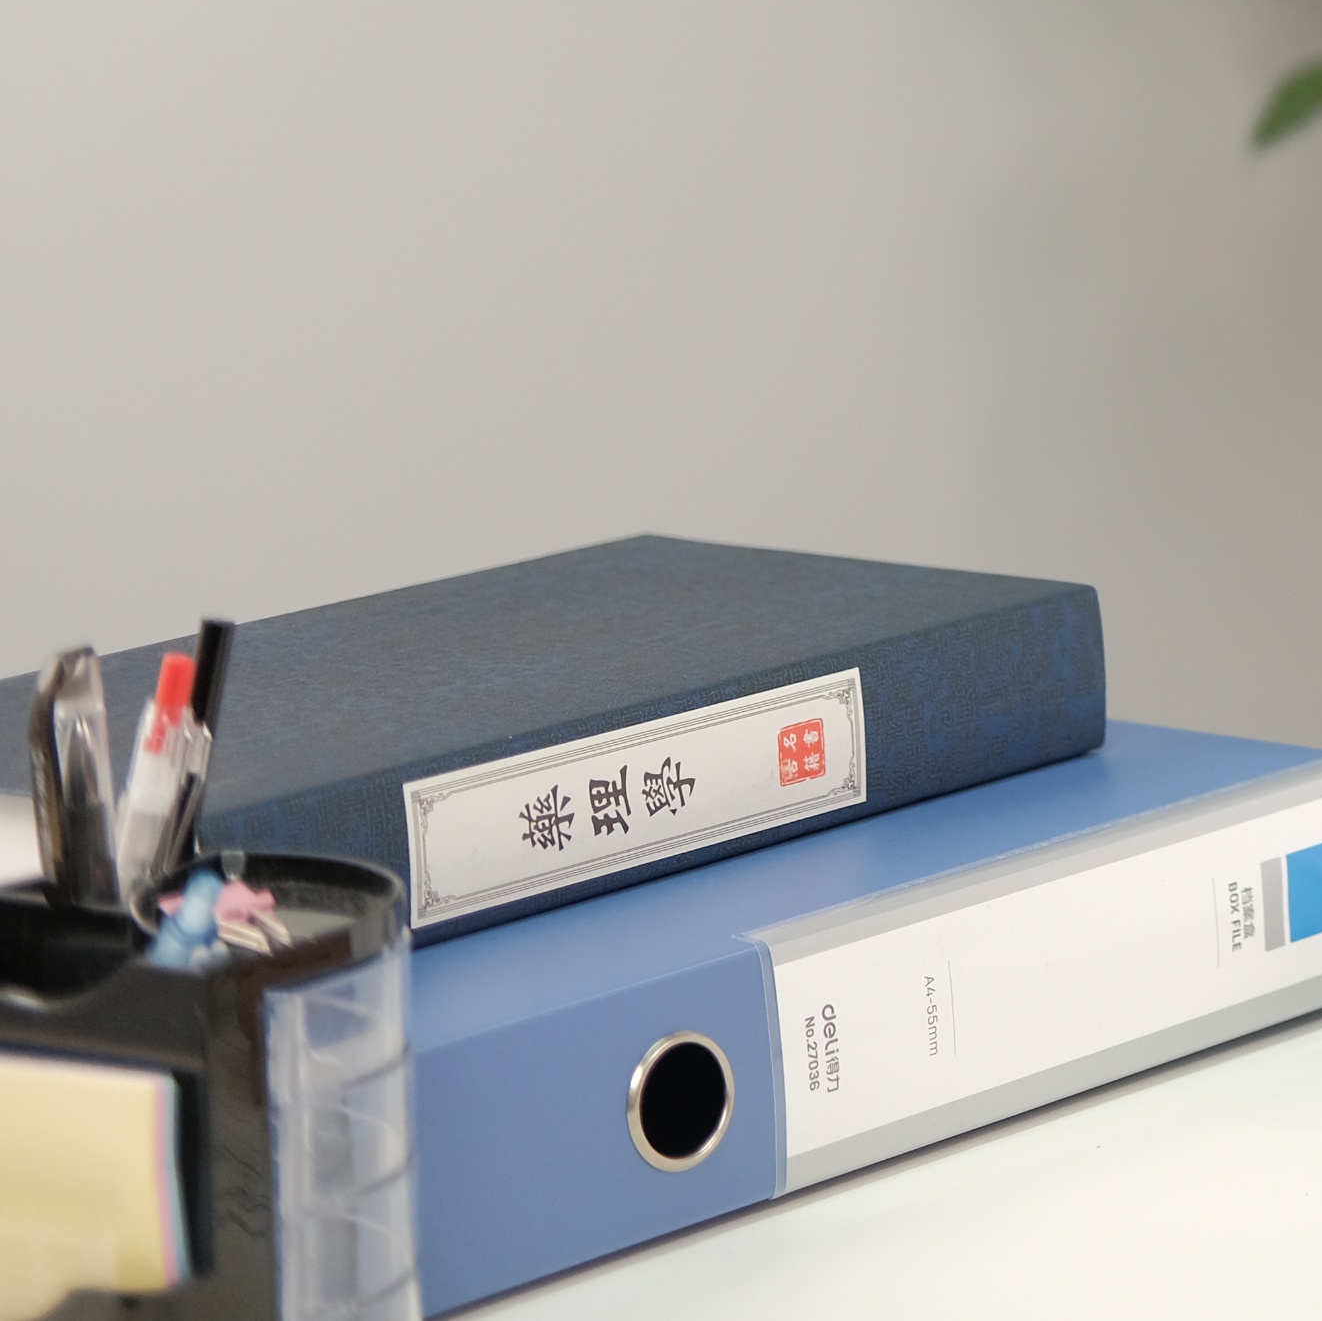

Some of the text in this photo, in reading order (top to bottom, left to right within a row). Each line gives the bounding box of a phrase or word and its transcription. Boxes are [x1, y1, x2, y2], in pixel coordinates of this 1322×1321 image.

[518, 756, 696, 852] 藥理學
[1228, 881, 1242, 952] BOX FILE
[1241, 886, 1255, 940] 档案盒
[804, 1015, 821, 1092] No.27036
[924, 974, 940, 1057] A4-55mm
